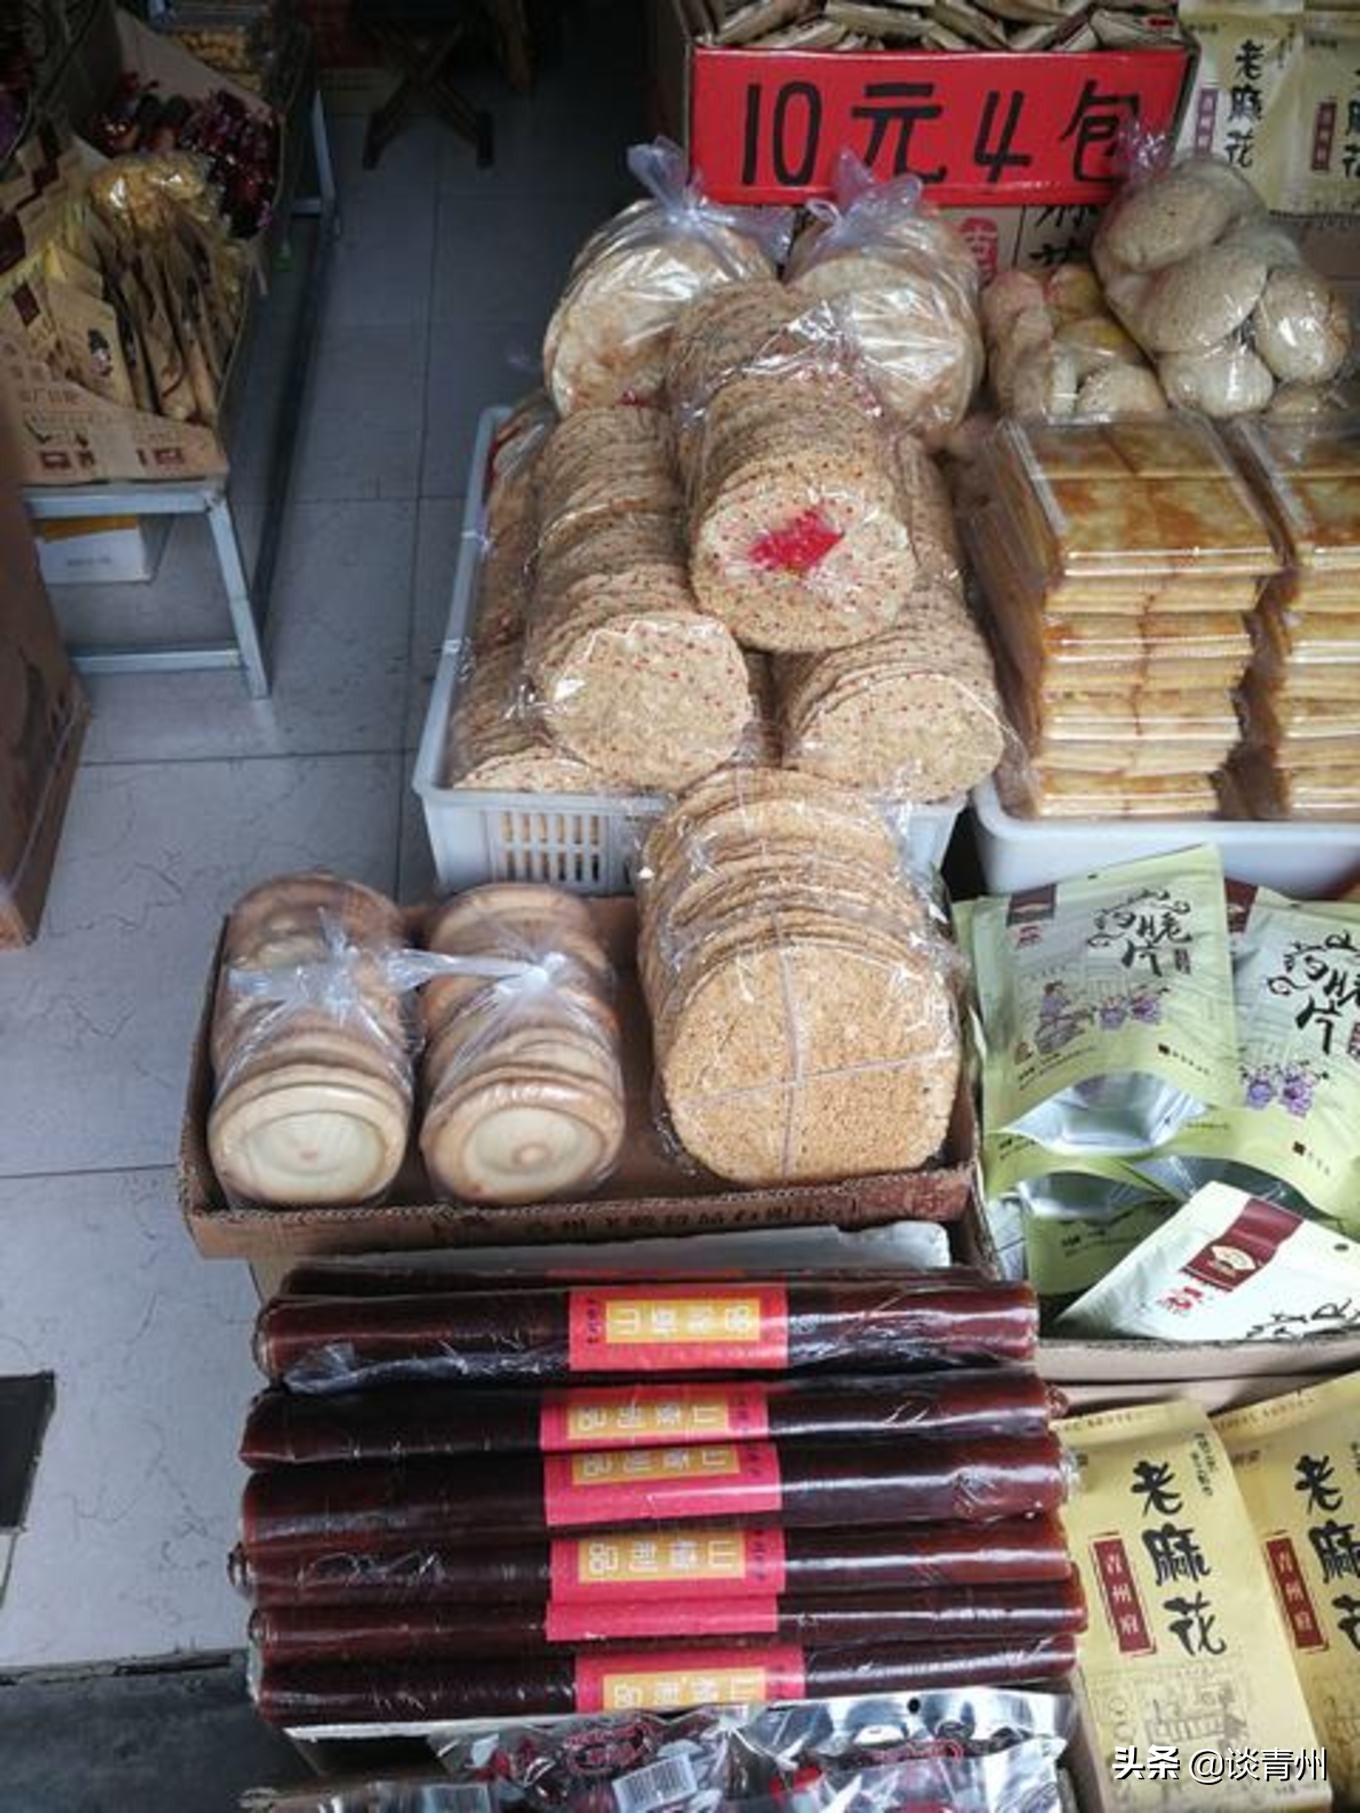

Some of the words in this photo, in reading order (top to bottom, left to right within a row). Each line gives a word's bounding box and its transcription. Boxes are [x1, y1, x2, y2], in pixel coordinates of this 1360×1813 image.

[1225, 39, 1265, 168] 老麻花
[1130, 1459, 1228, 1656] 老麻花
